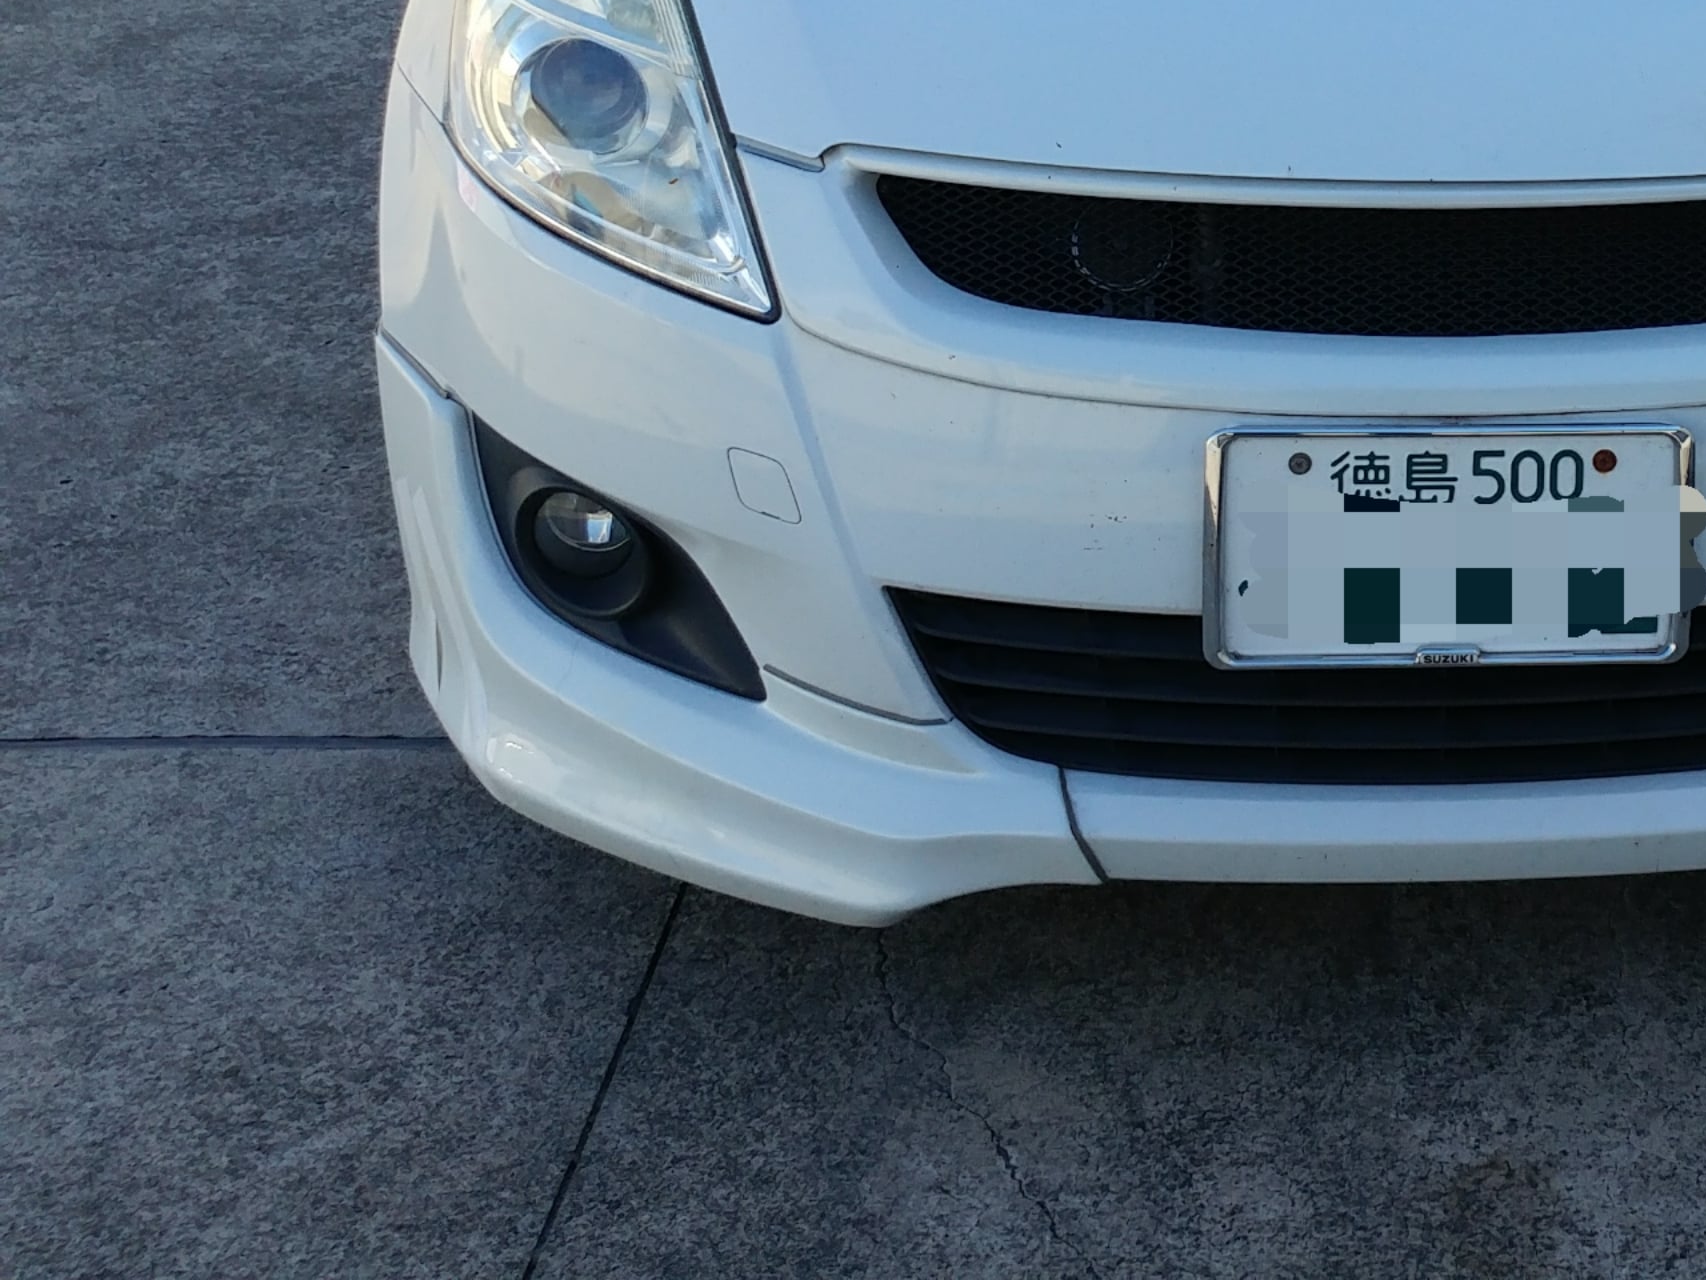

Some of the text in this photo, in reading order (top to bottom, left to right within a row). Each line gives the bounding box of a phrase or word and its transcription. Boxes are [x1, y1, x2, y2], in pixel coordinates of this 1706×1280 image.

[1329, 449, 1585, 505] 徳島 500
[1423, 653, 1474, 665] SUZUKI
